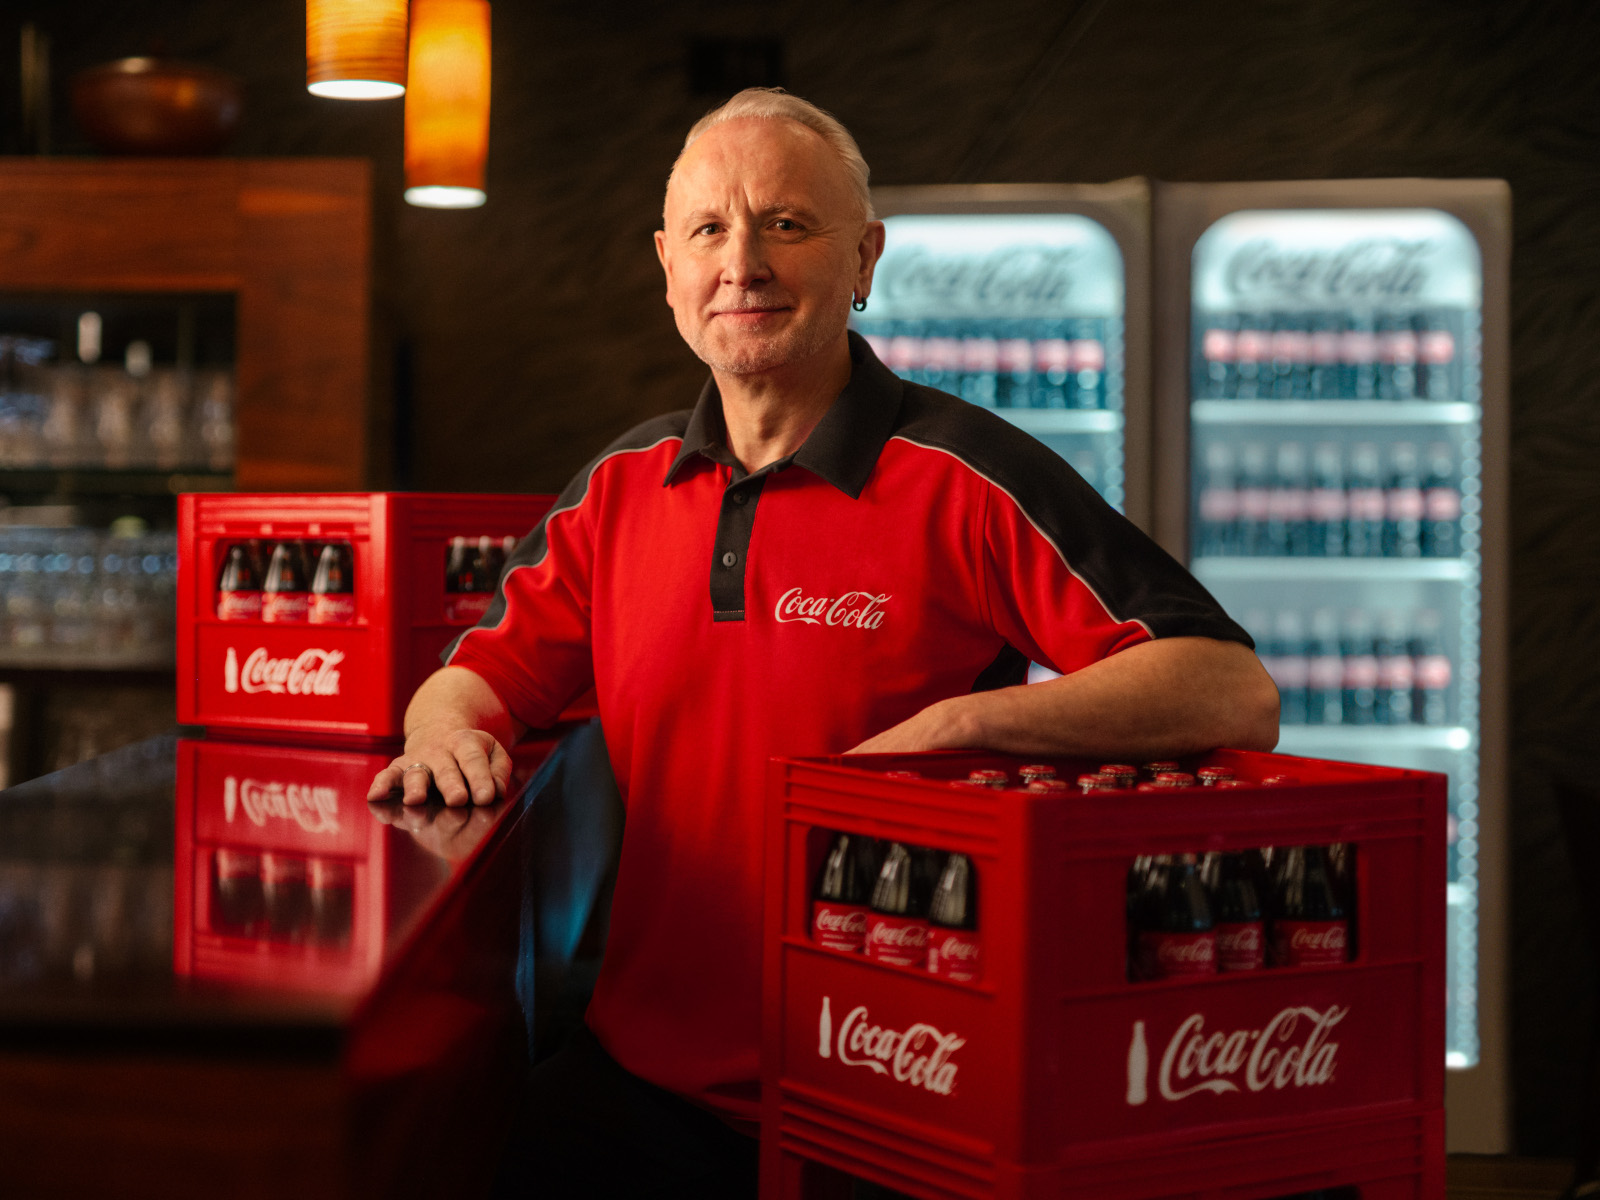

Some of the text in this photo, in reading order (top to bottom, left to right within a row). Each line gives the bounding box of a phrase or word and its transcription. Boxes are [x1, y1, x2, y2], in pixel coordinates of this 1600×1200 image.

[775, 587, 893, 630] Coca-Cola
[241, 647, 345, 696] Coca-Cola
[838, 1005, 967, 1095] Coca-Cola
[1159, 1004, 1350, 1101] Coca-Cola
